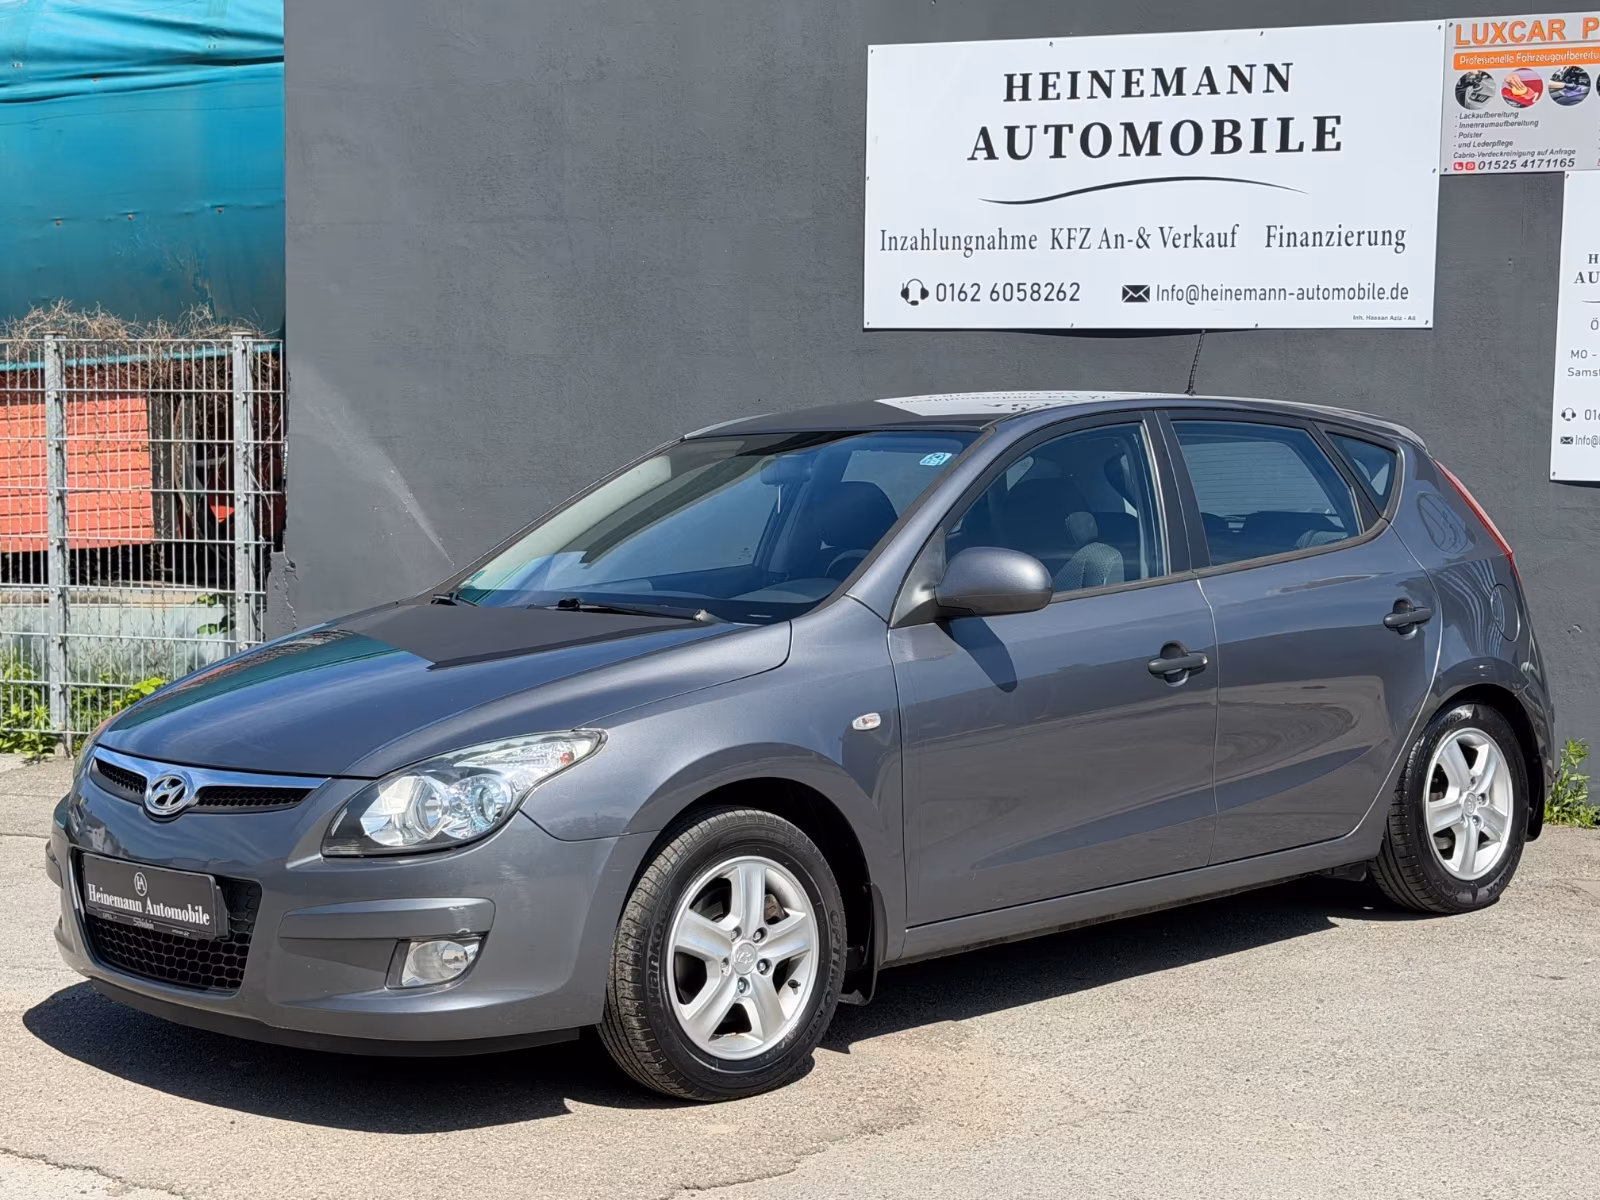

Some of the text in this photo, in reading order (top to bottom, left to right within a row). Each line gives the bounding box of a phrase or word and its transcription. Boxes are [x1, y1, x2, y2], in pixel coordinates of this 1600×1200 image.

[1455, 17, 1600, 45] LUXCAR P
[1460, 53, 1514, 64] Professionelle
[1003, 63, 1293, 102] HEINEMANN
[1459, 111, 1519, 120] Lackaufbereitung
[1459, 120, 1539, 129] Innenraumaufbereitung
[967, 116, 1342, 160] AUTOMOBILE
[1458, 131, 1483, 139] Polster
[1472, 140, 1513, 149] Lederpflege
[1453, 150, 1535, 159] Cabrio-Verdeckreinigung
[1549, 148, 1576, 156] Anfrage
[1478, 158, 1575, 170] 01525 4171165
[880, 228, 1038, 258] Inzahlungnahme
[1050, 228, 1092, 250] KFZ
[1158, 224, 1240, 249] Verkauf
[1264, 224, 1407, 255] Finanzierung
[1588, 254, 1600, 265] H
[1574, 271, 1600, 284] AU
[935, 282, 1081, 303] 0162 6058262
[1156, 282, 1409, 304] Info@heinemann-automobile.de
[1571, 349, 1588, 359] MO
[1575, 435, 1600, 448] Info@
[88, 883, 143, 913] Heinemann
[145, 897, 210, 926] Automobile
